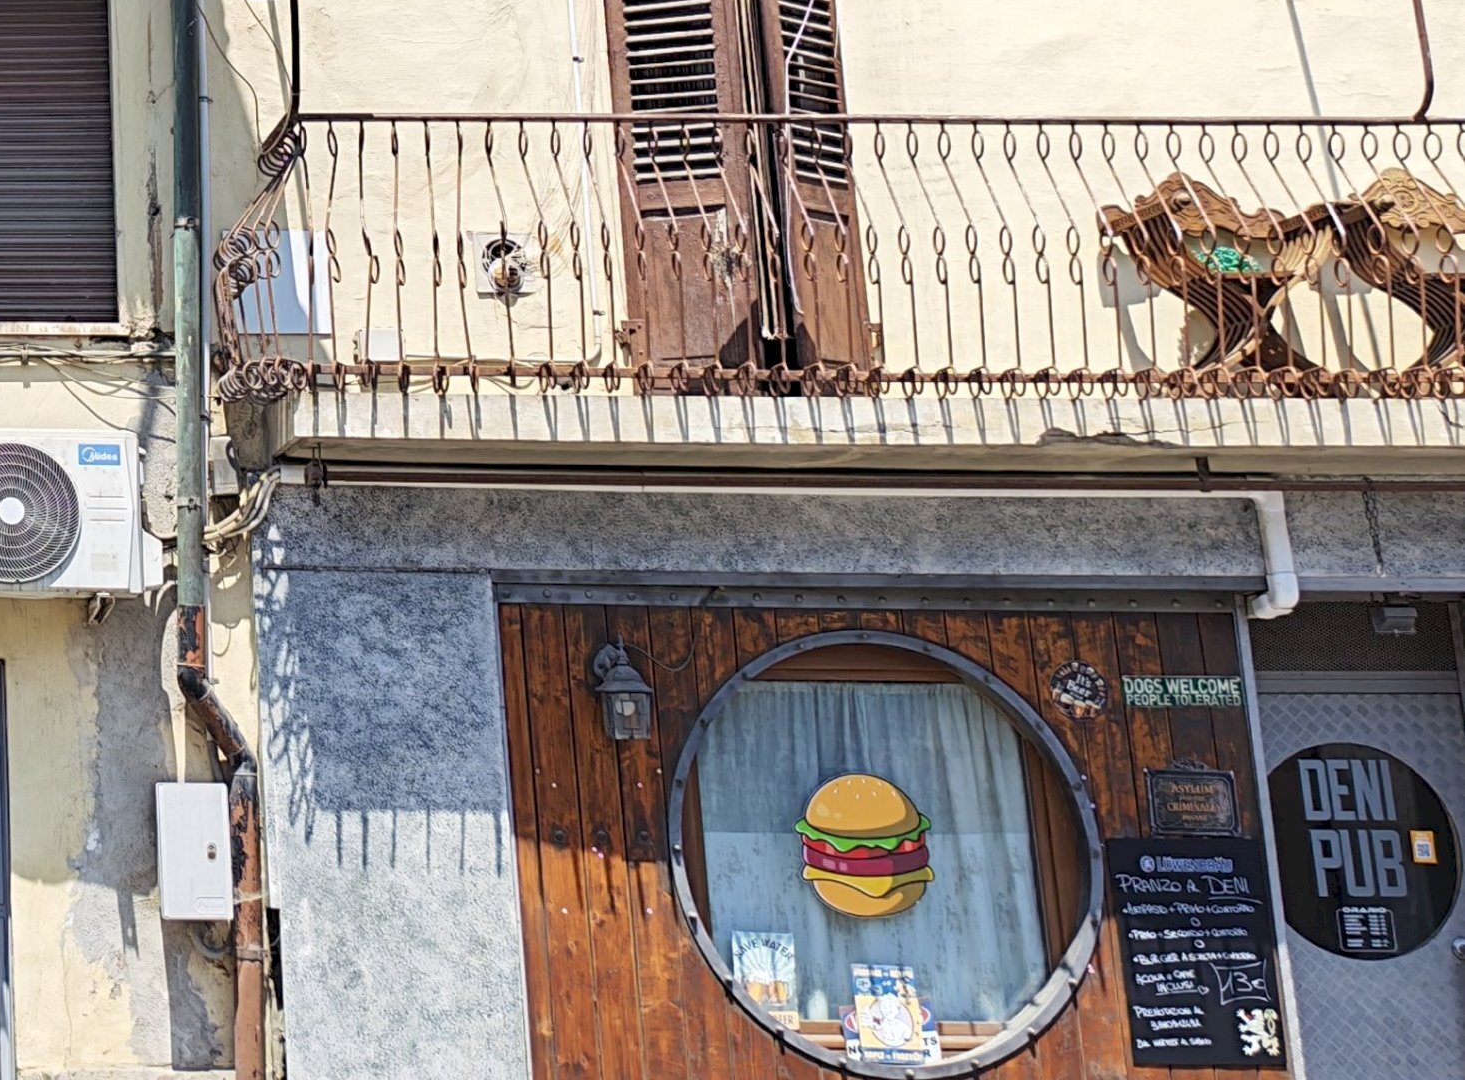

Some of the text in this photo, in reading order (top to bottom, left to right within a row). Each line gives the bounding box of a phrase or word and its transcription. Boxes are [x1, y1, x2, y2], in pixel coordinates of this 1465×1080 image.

[1124, 678, 1163, 694] DOGS
[1167, 678, 1240, 694] WELCOME
[1126, 694, 1241, 706] PEOPLE TOLERATED
[1297, 759, 1398, 821] DENI
[1309, 829, 1408, 897] PUB
[1115, 873, 1182, 893] PRANZO
[1200, 875, 1250, 894] DENI
[734, 938, 794, 960] SAVE WATER
[1137, 953, 1180, 965] BURGER
